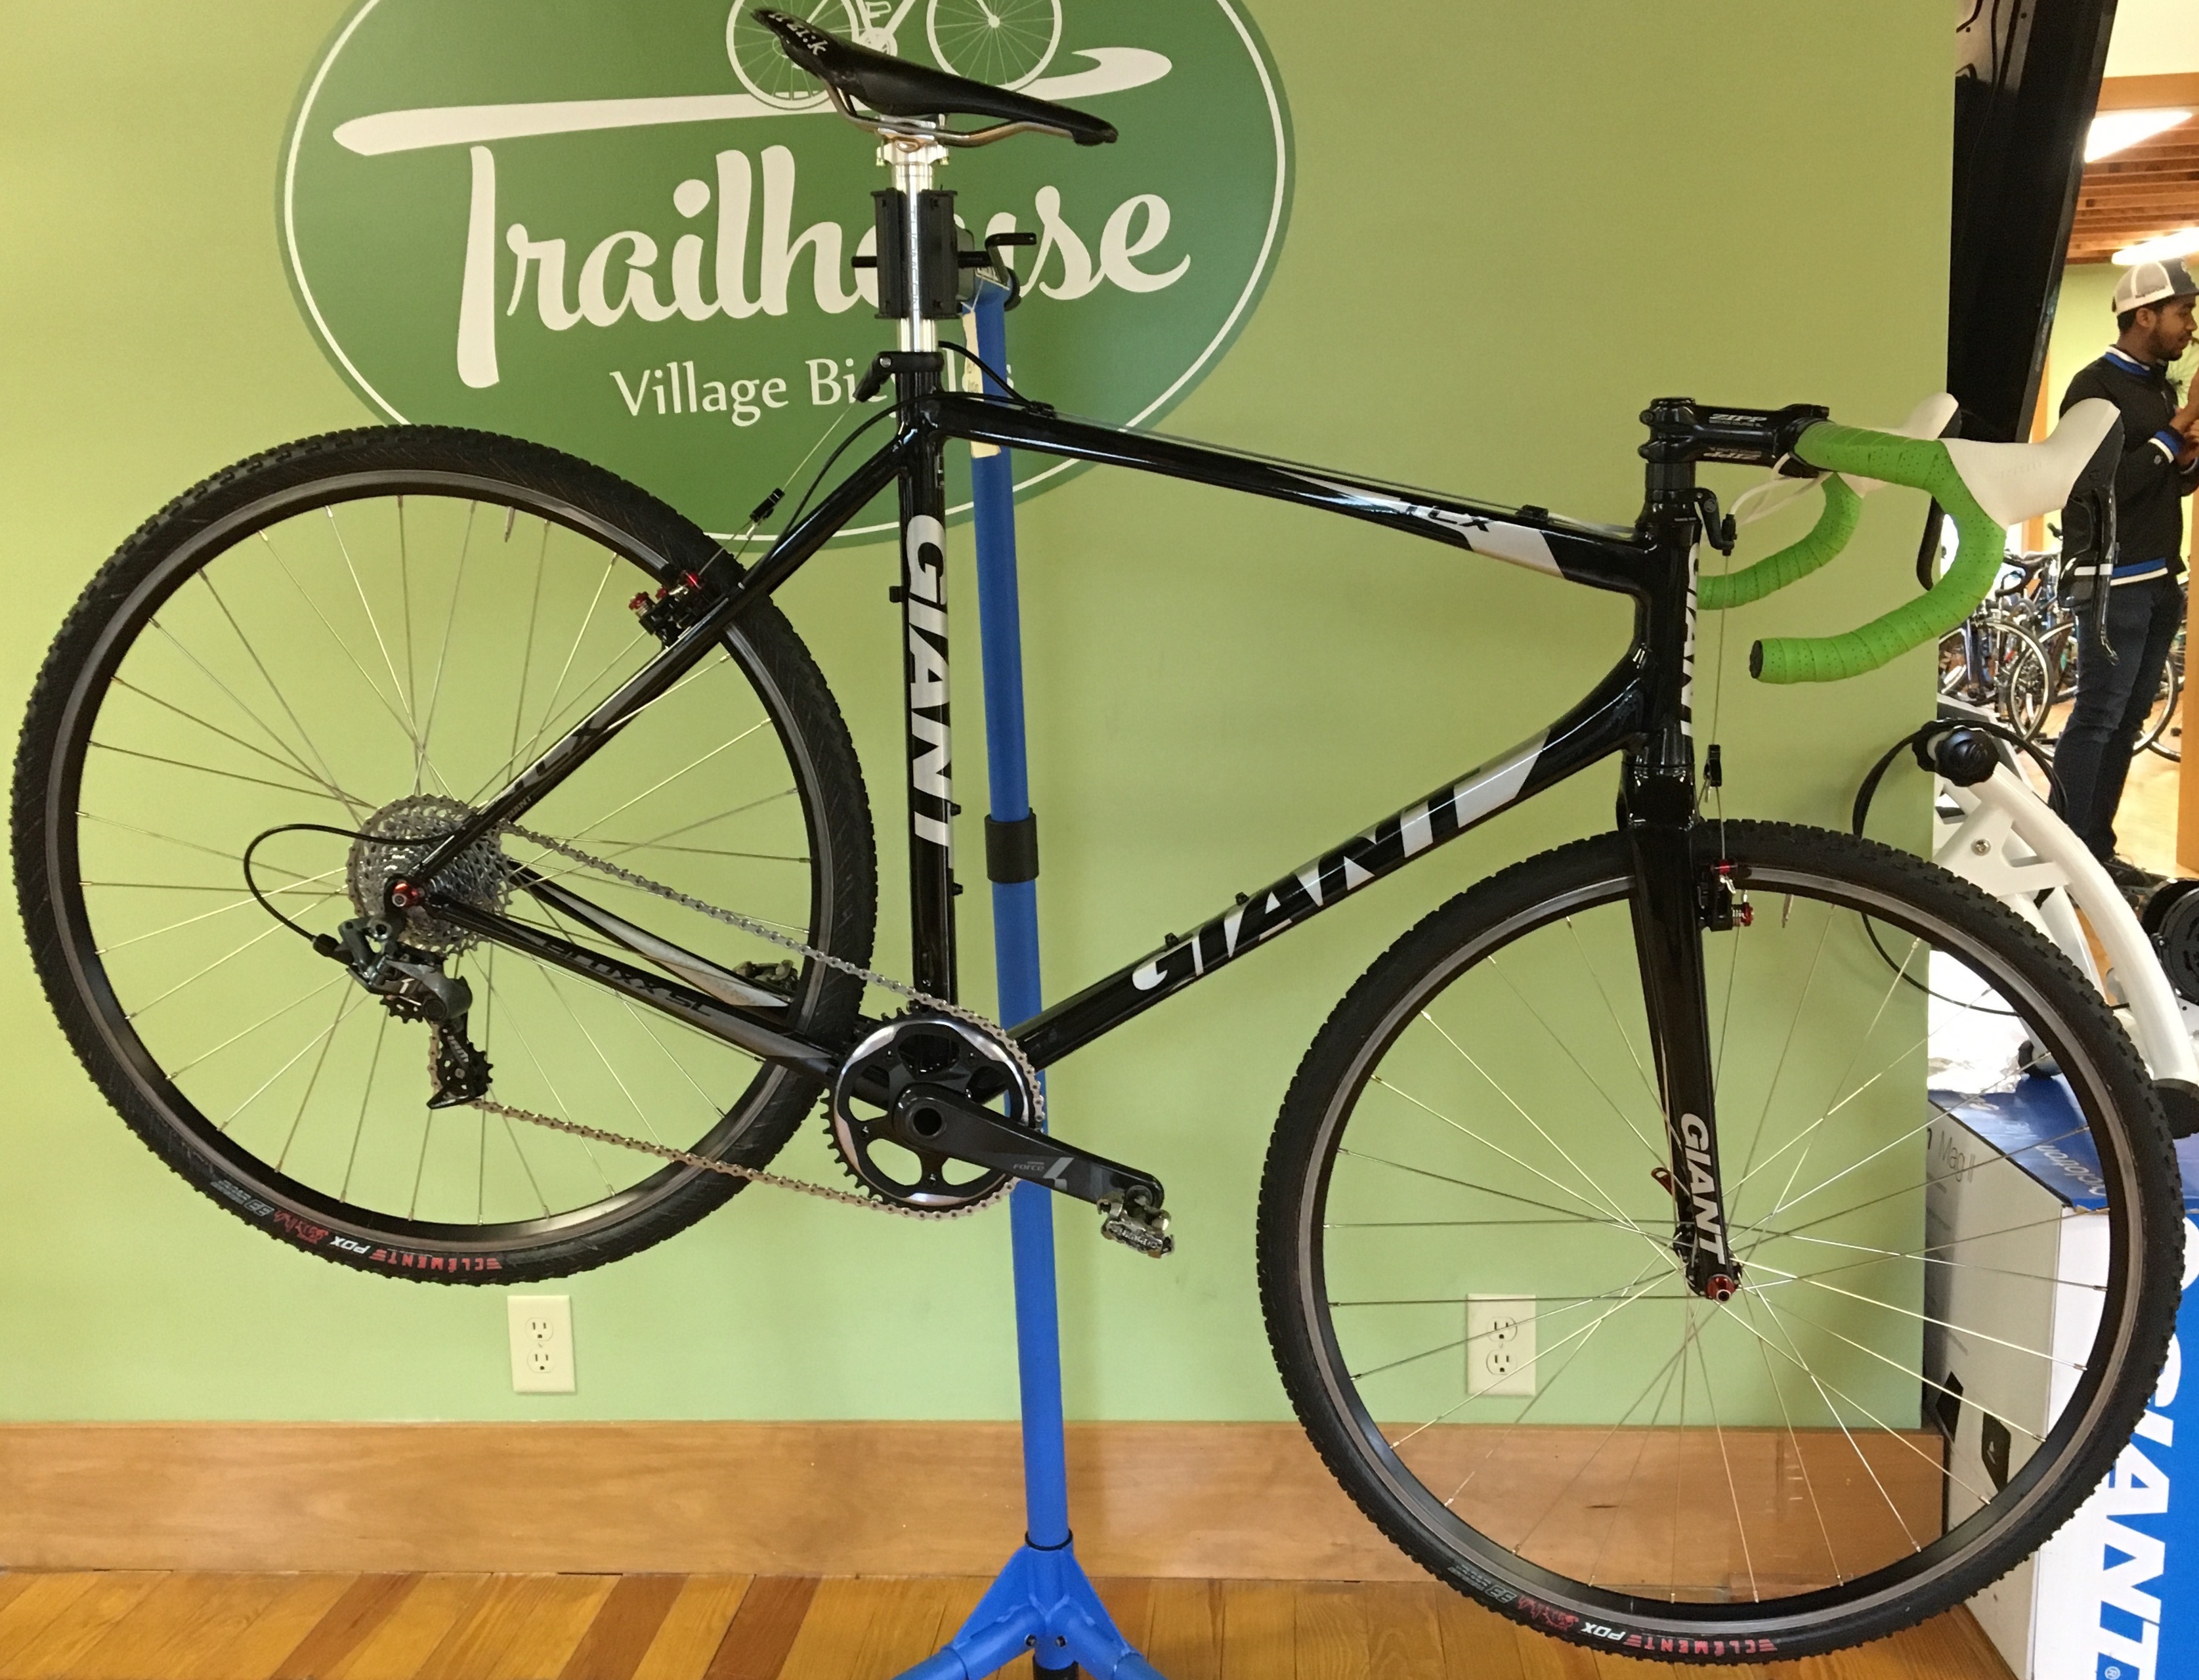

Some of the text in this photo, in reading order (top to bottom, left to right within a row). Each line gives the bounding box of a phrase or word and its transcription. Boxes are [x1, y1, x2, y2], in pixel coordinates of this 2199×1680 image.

[331, 47, 1191, 389] Trailhse
[609, 360, 788, 427] Village
[907, 515, 954, 869] GIANT
[1681, 1113, 1726, 1264] GIANT
[330, 1236, 372, 1255] PDX
[1581, 1620, 1627, 1641] PDX
